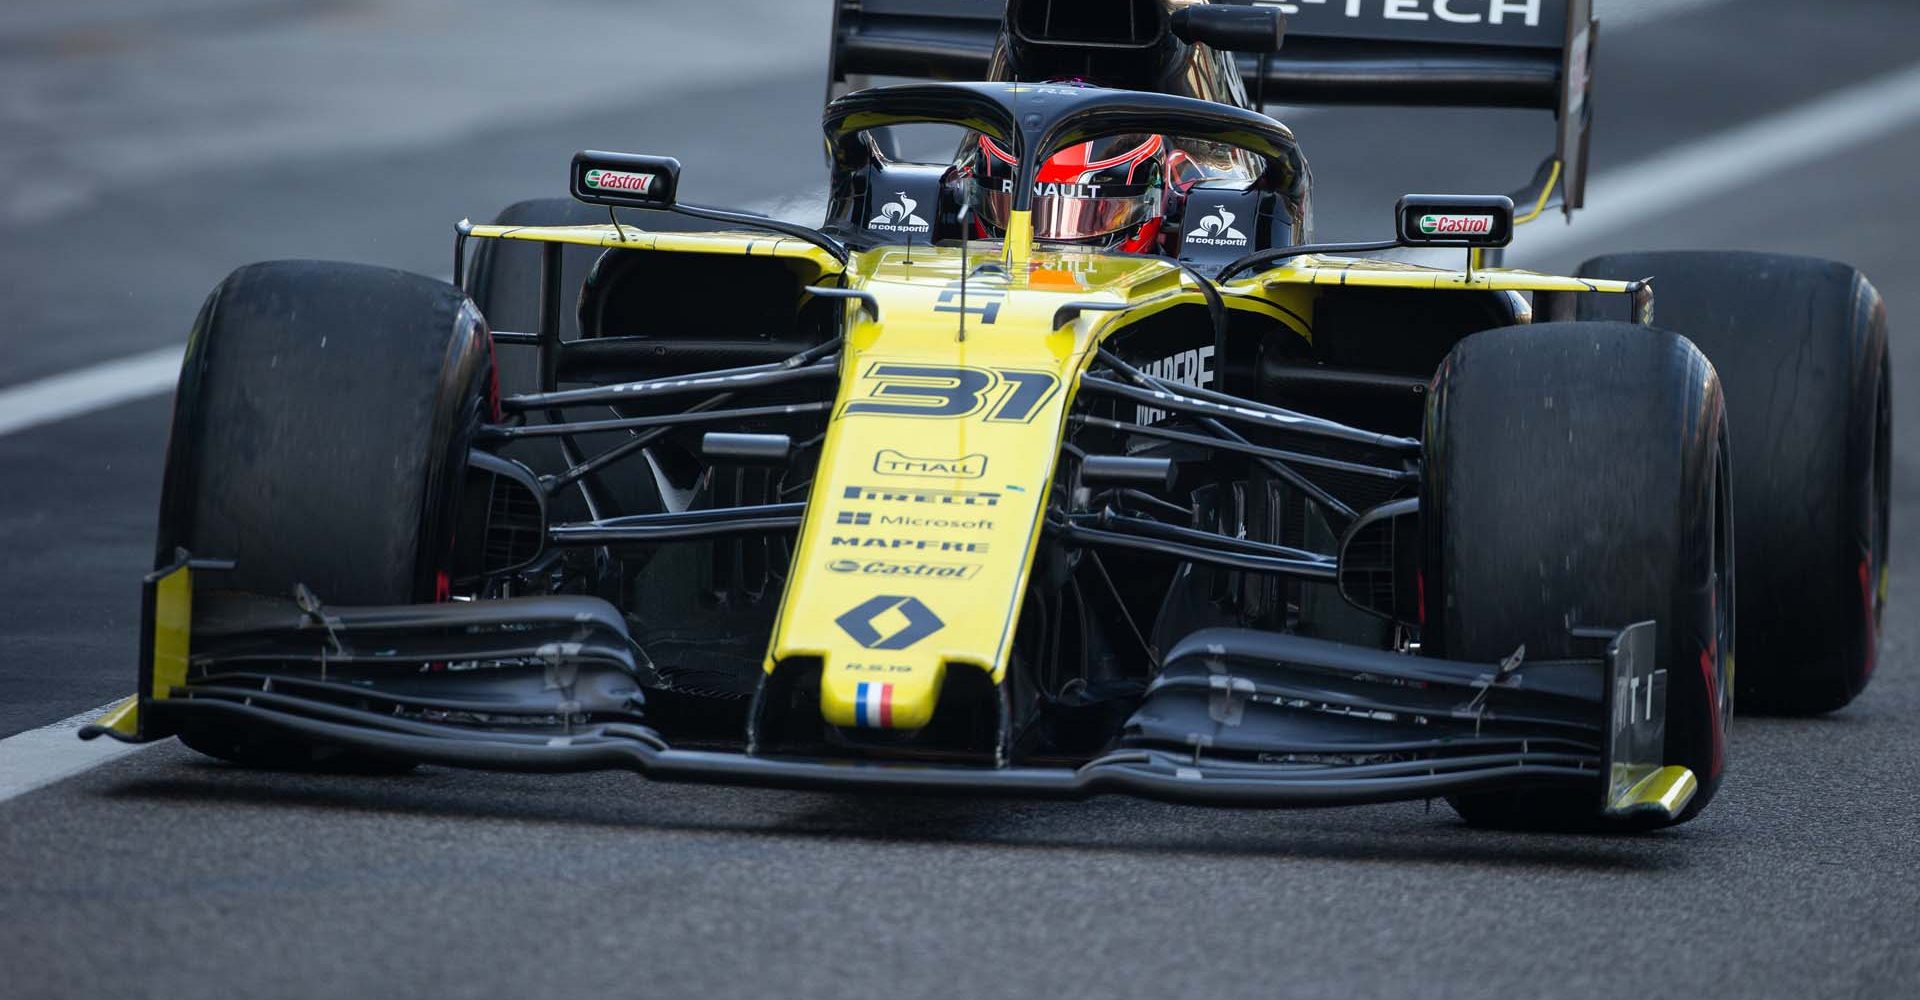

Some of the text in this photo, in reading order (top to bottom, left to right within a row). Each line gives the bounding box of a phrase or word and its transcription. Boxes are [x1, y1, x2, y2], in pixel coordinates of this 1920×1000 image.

[600, 172, 649, 191] Castrol
[1001, 179, 1101, 199] RNAULT
[868, 222, 929, 233] le coq sportif
[1437, 216, 1489, 233] Castrol
[1185, 235, 1247, 247] le coq sportif
[835, 362, 1062, 424] 31
[883, 460, 976, 474] TMALL
[843, 486, 1002, 506] PIRELLI
[880, 515, 994, 530] Microsoft
[831, 536, 990, 553] MAPFRE
[862, 560, 969, 579] Castrol
